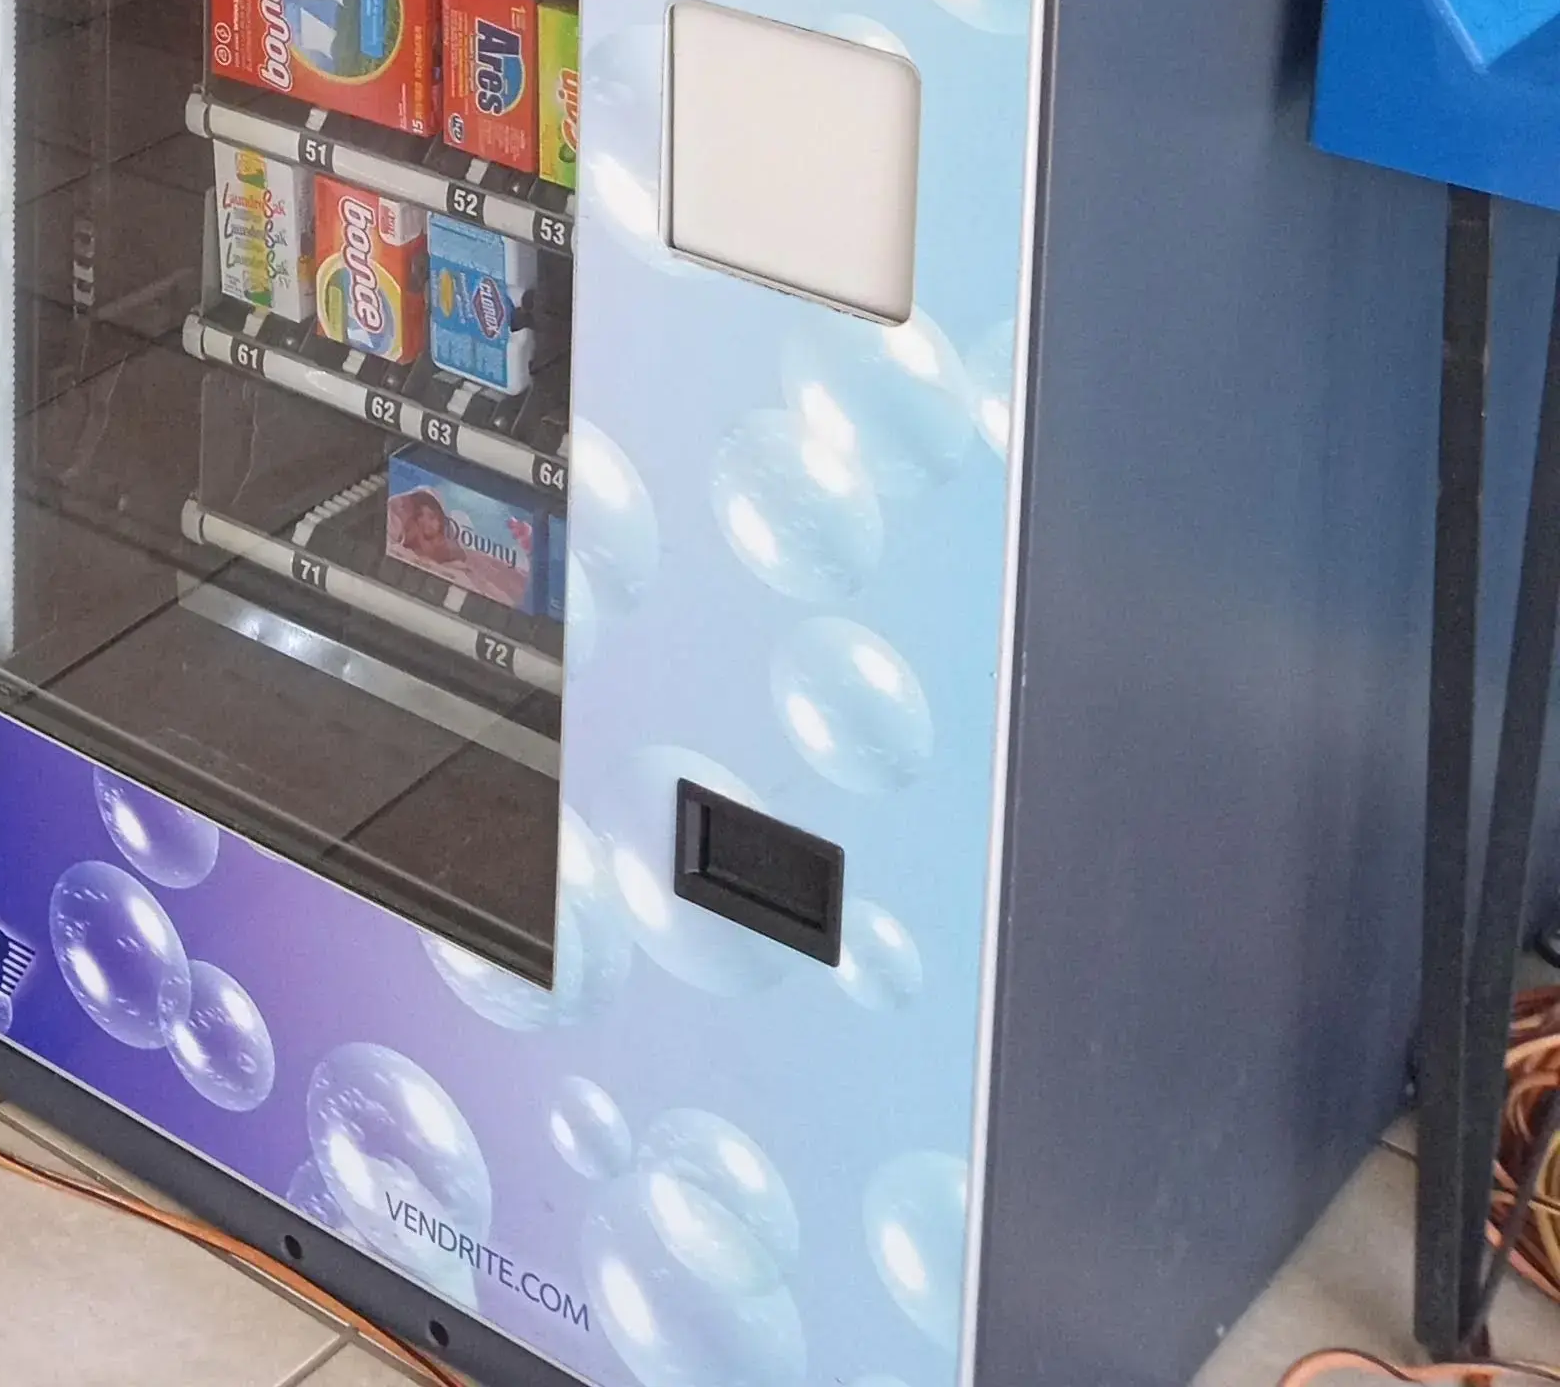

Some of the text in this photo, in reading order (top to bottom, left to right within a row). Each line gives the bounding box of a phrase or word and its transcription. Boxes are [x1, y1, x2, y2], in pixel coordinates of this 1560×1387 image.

[475, 17, 522, 116] Ares
[305, 139, 565, 245] 51 52 53
[339, 196, 384, 334] bounce
[479, 282, 501, 334] CLOROX
[237, 343, 564, 490] 61 62 63 64
[445, 516, 518, 568] Downy
[300, 560, 508, 665] 71 72
[385, 1191, 590, 1332] VENDRITE.COM
